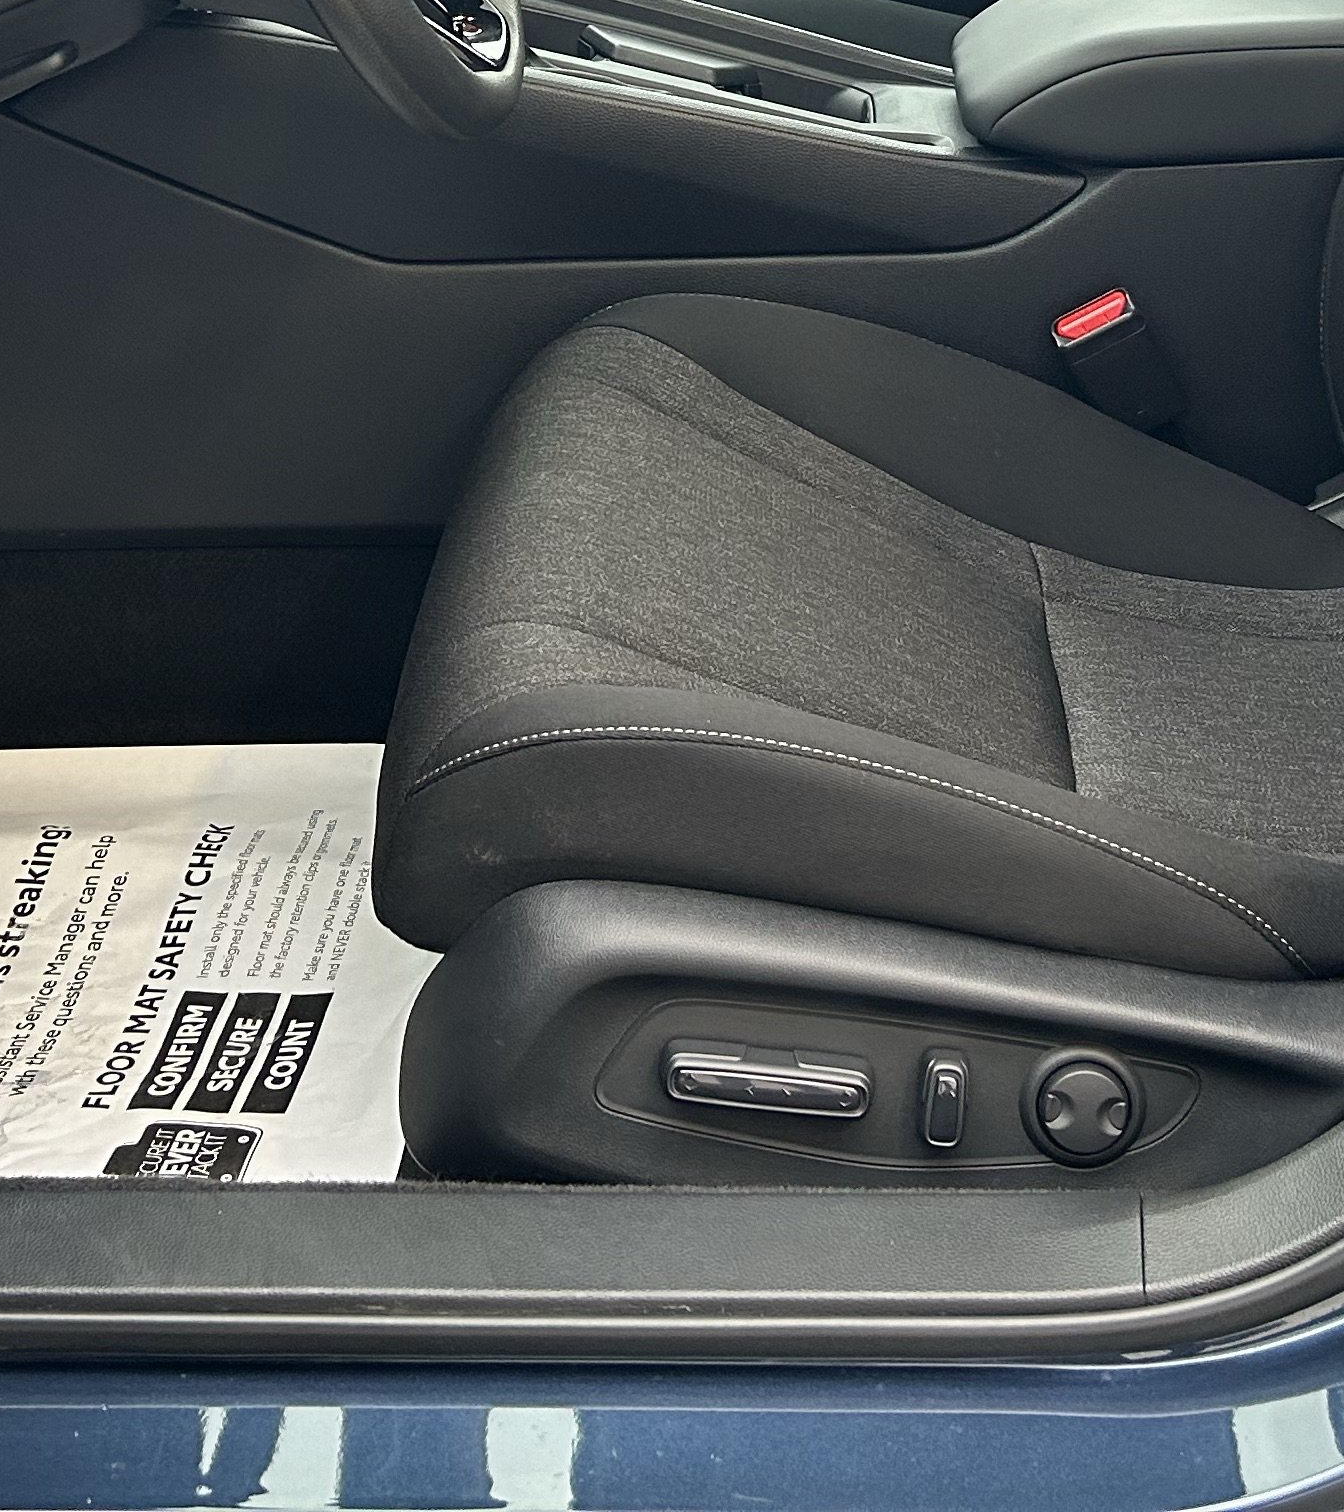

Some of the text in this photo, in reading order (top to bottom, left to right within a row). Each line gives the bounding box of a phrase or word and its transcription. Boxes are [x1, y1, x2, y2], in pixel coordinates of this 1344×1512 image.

[84, 835, 117, 869] help
[79, 876, 100, 904] can
[226, 858, 248, 900] specified
[336, 869, 349, 887] one
[355, 867, 370, 892] stack
[217, 903, 232, 919] the
[265, 896, 285, 929] should
[290, 884, 312, 925] retention
[324, 889, 343, 911] have
[342, 894, 362, 927] double
[211, 921, 228, 943] only
[219, 929, 244, 977] designed
[234, 913, 249, 927] for
[243, 889, 257, 911] your
[324, 913, 335, 932] you
[43, 907, 87, 975] Manager
[260, 931, 274, 949] mat
[274, 926, 299, 960] factory
[314, 933, 328, 954] sure
[330, 930, 352, 960] NEVER
[25, 1030, 61, 1066] these
[53, 955, 96, 1026] questions
[88, 921, 111, 951] and
[103, 872, 129, 916] more.
[81, 824, 235, 1109] FLOOR MAT SAFETY CHECK
[196, 945, 217, 978] Install
[247, 951, 265, 977] Floor
[269, 962, 284, 979] the
[302, 956, 321, 981] Make
[327, 964, 340, 981] and
[16, 980, 57, 1030] Service
[147, 1005, 213, 1096] CONFIRM
[206, 1018, 263, 1091] SECURE
[264, 1019, 314, 1090] COUNT
[156, 1127, 175, 1139] IT
[158, 1129, 207, 1178] EVER
[186, 1131, 227, 1179] TACK IT
